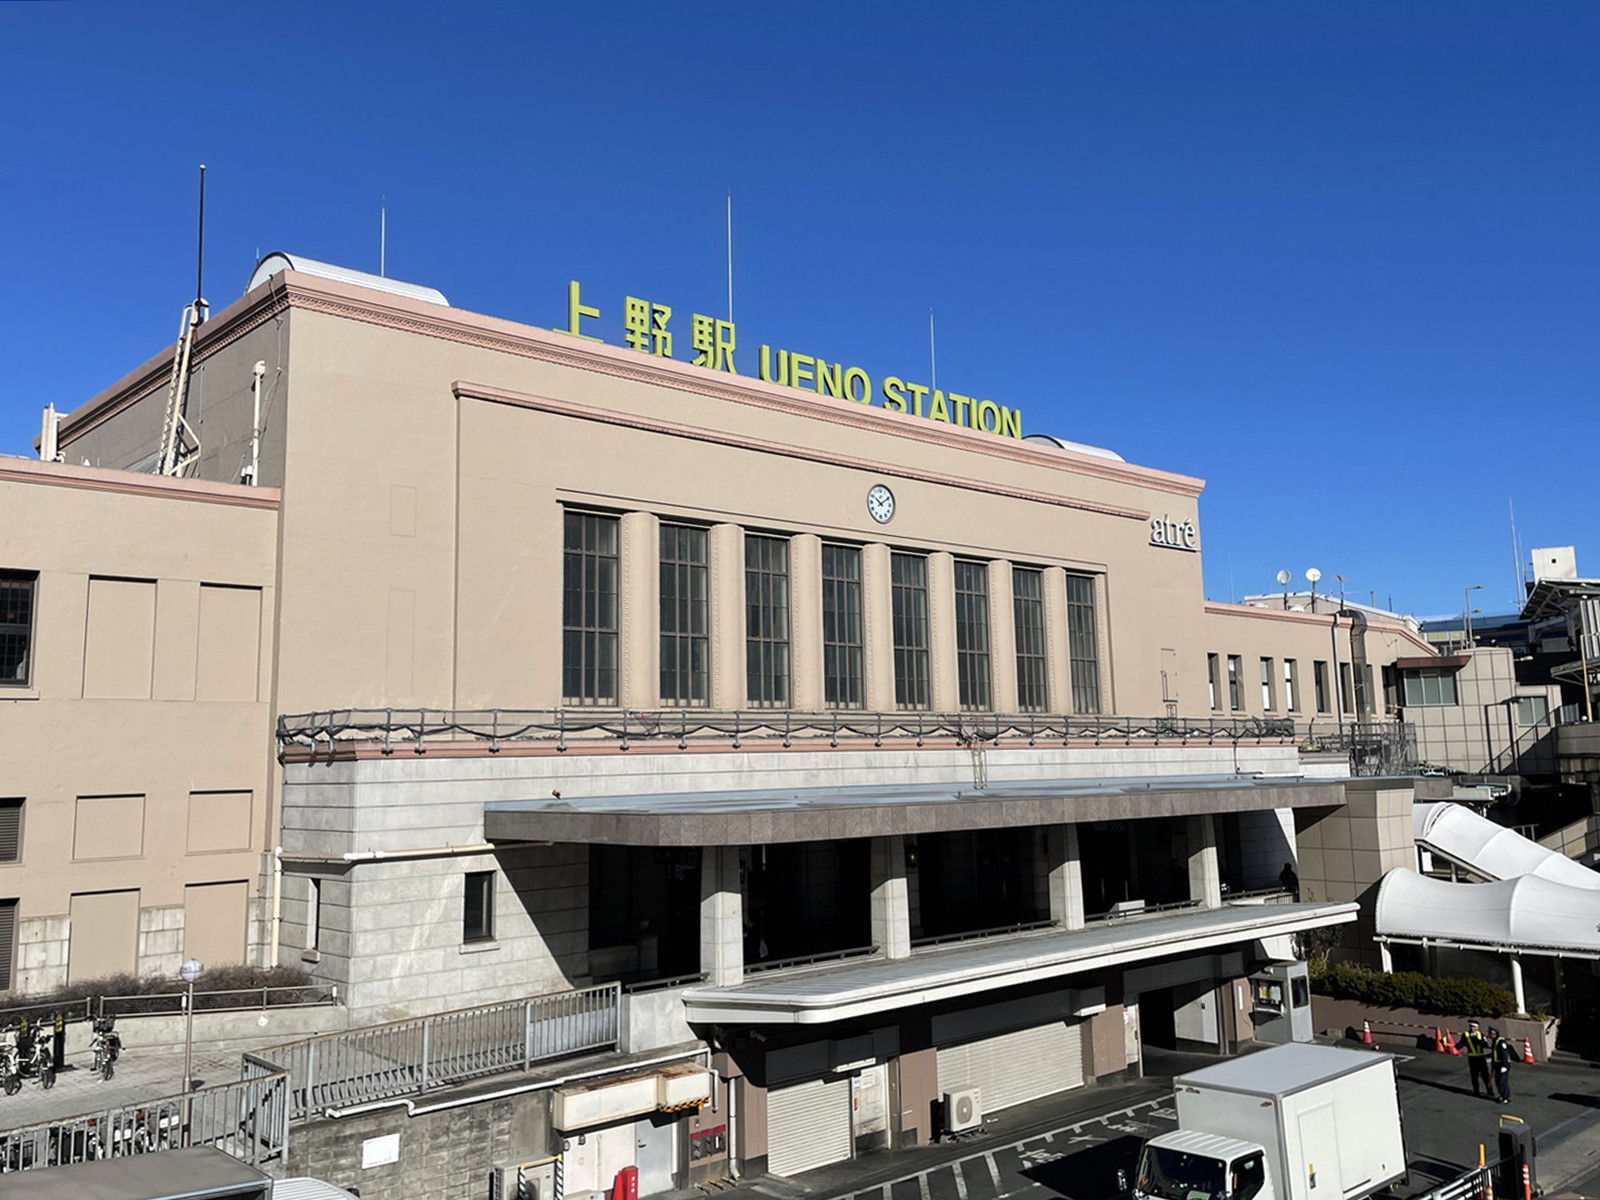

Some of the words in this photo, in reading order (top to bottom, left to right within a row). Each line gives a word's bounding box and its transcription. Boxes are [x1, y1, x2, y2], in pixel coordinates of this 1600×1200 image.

[552, 280, 737, 374] 上野駅
[759, 344, 872, 405] UENO
[882, 376, 1021, 440] STATION
[1150, 513, 1196, 549] atré
